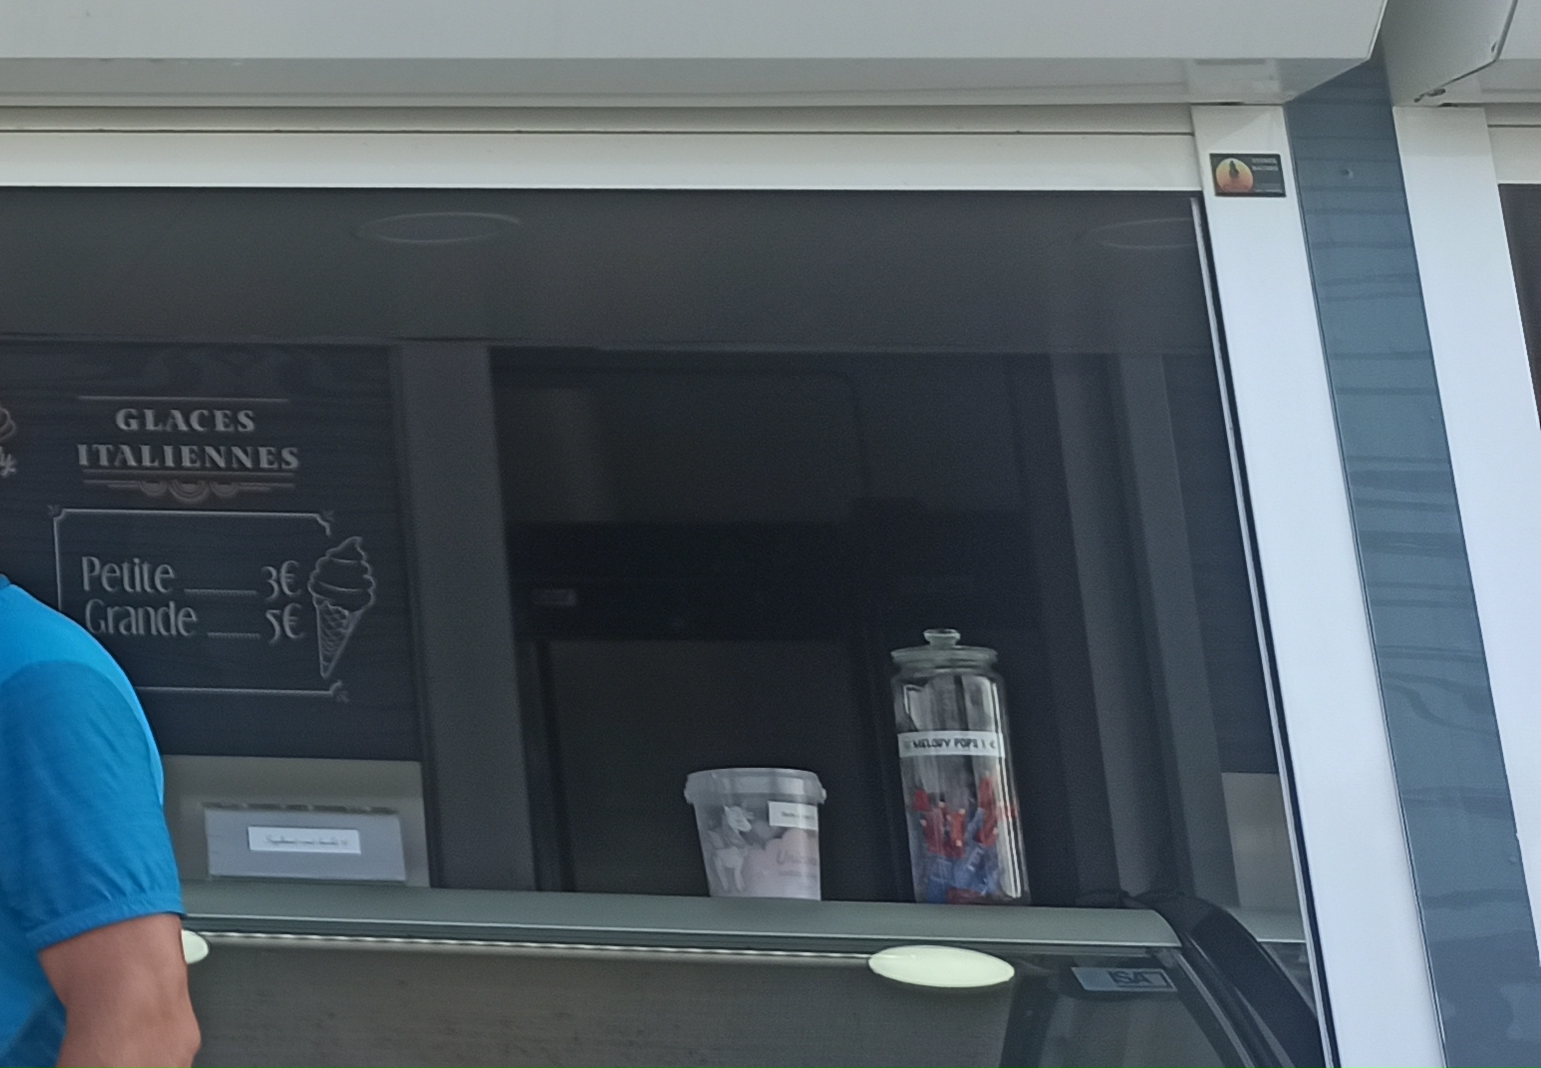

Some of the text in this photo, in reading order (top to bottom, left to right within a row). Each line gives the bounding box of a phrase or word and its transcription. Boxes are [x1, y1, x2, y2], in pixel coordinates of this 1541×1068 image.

[115, 407, 256, 432] GLACES
[76, 443, 300, 470] ITALIENNES
[81, 555, 303, 600] Petite 3€
[84, 597, 304, 644] Grande 5€
